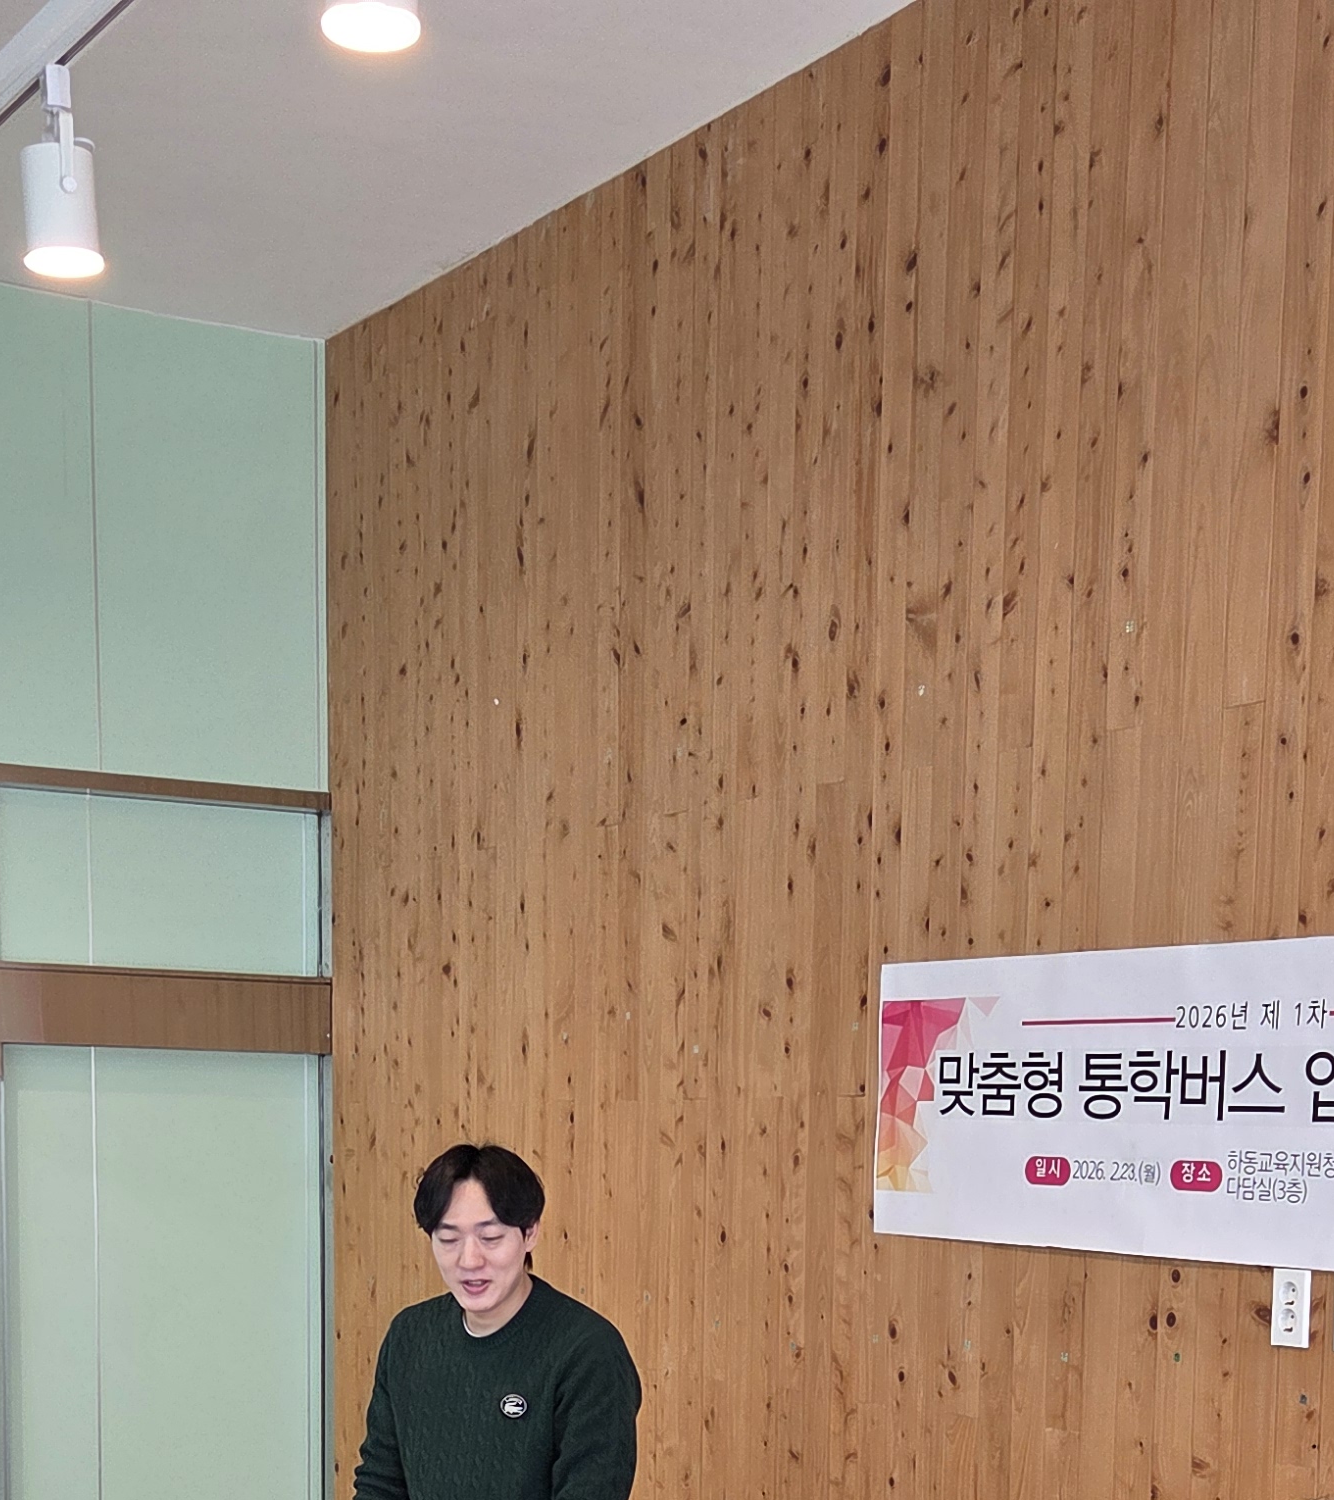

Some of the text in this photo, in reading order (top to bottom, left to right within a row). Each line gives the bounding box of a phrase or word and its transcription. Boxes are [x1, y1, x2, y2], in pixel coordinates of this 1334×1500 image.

[1175, 998, 1329, 1031] 2026년 제 1차
[937, 1050, 1064, 1119] 맞춤형
[1078, 1048, 1286, 1122] 통학버스
[1034, 1157, 1062, 1179] 일시
[1072, 1159, 1106, 1181] 2026.
[1180, 1162, 1212, 1184] 장소
[1226, 1175, 1308, 1205] 다담실(3층)
